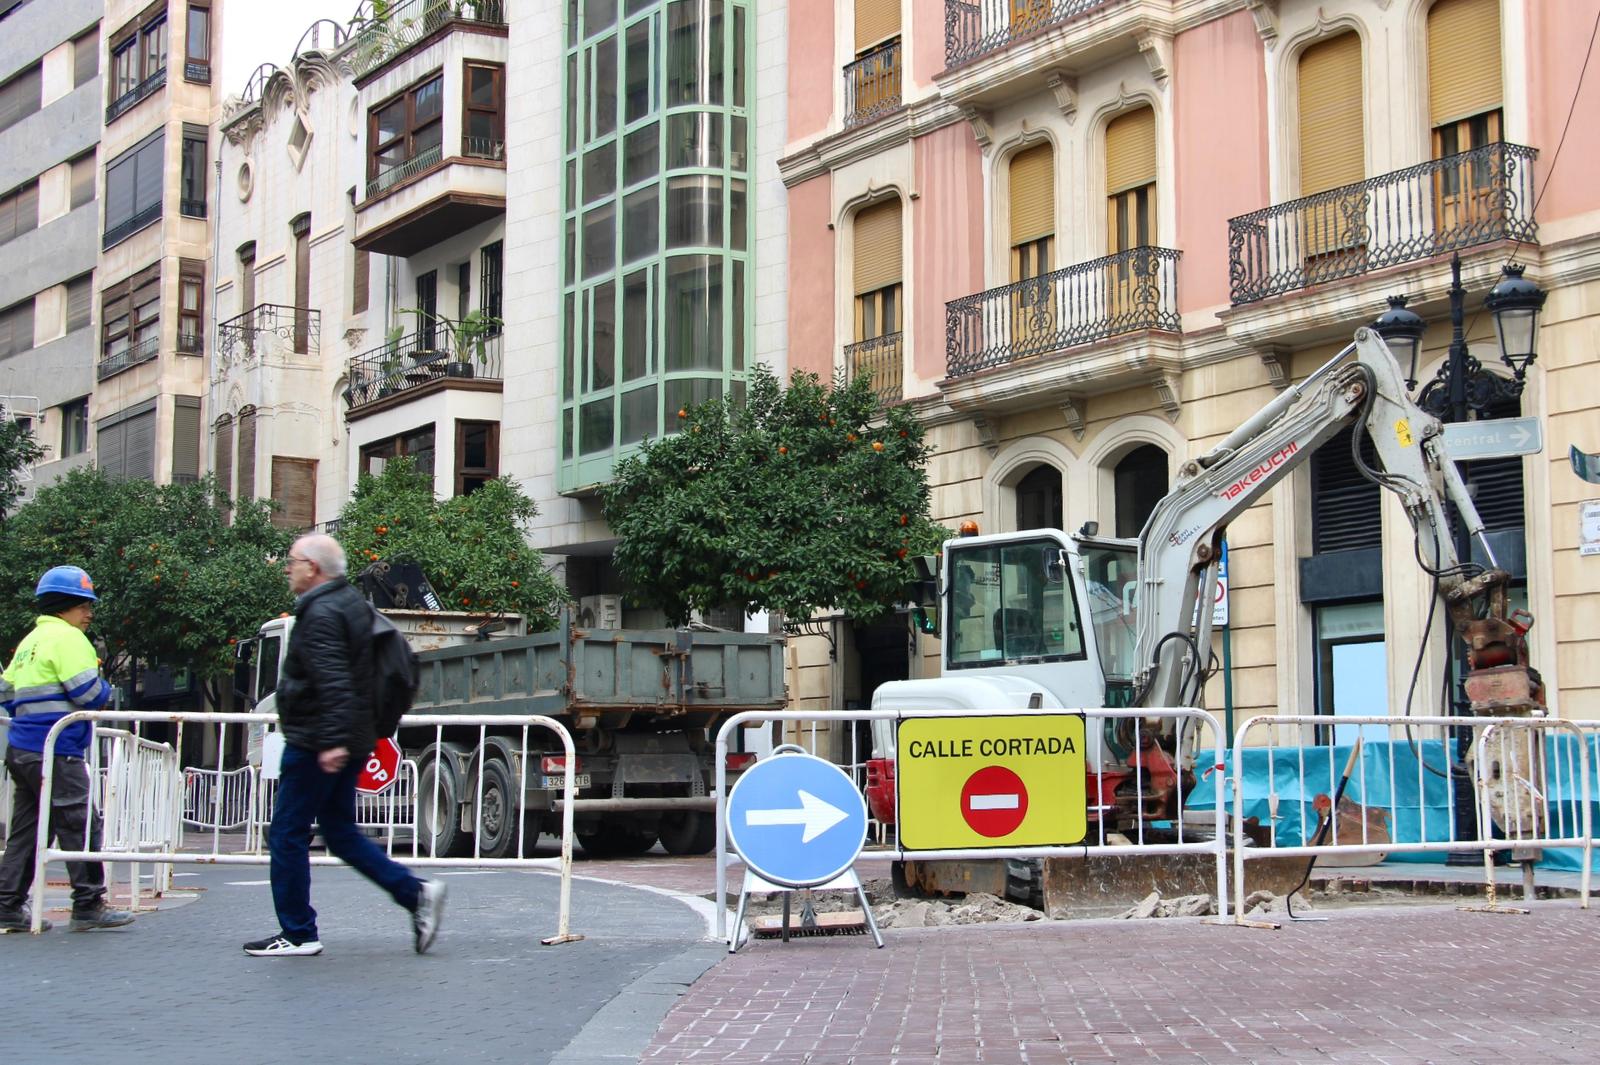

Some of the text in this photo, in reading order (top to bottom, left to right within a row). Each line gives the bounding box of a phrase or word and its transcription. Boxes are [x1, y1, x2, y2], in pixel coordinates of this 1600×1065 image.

[909, 737, 1076, 758] CALLE CORTADA
[548, 776, 565, 786] 326
